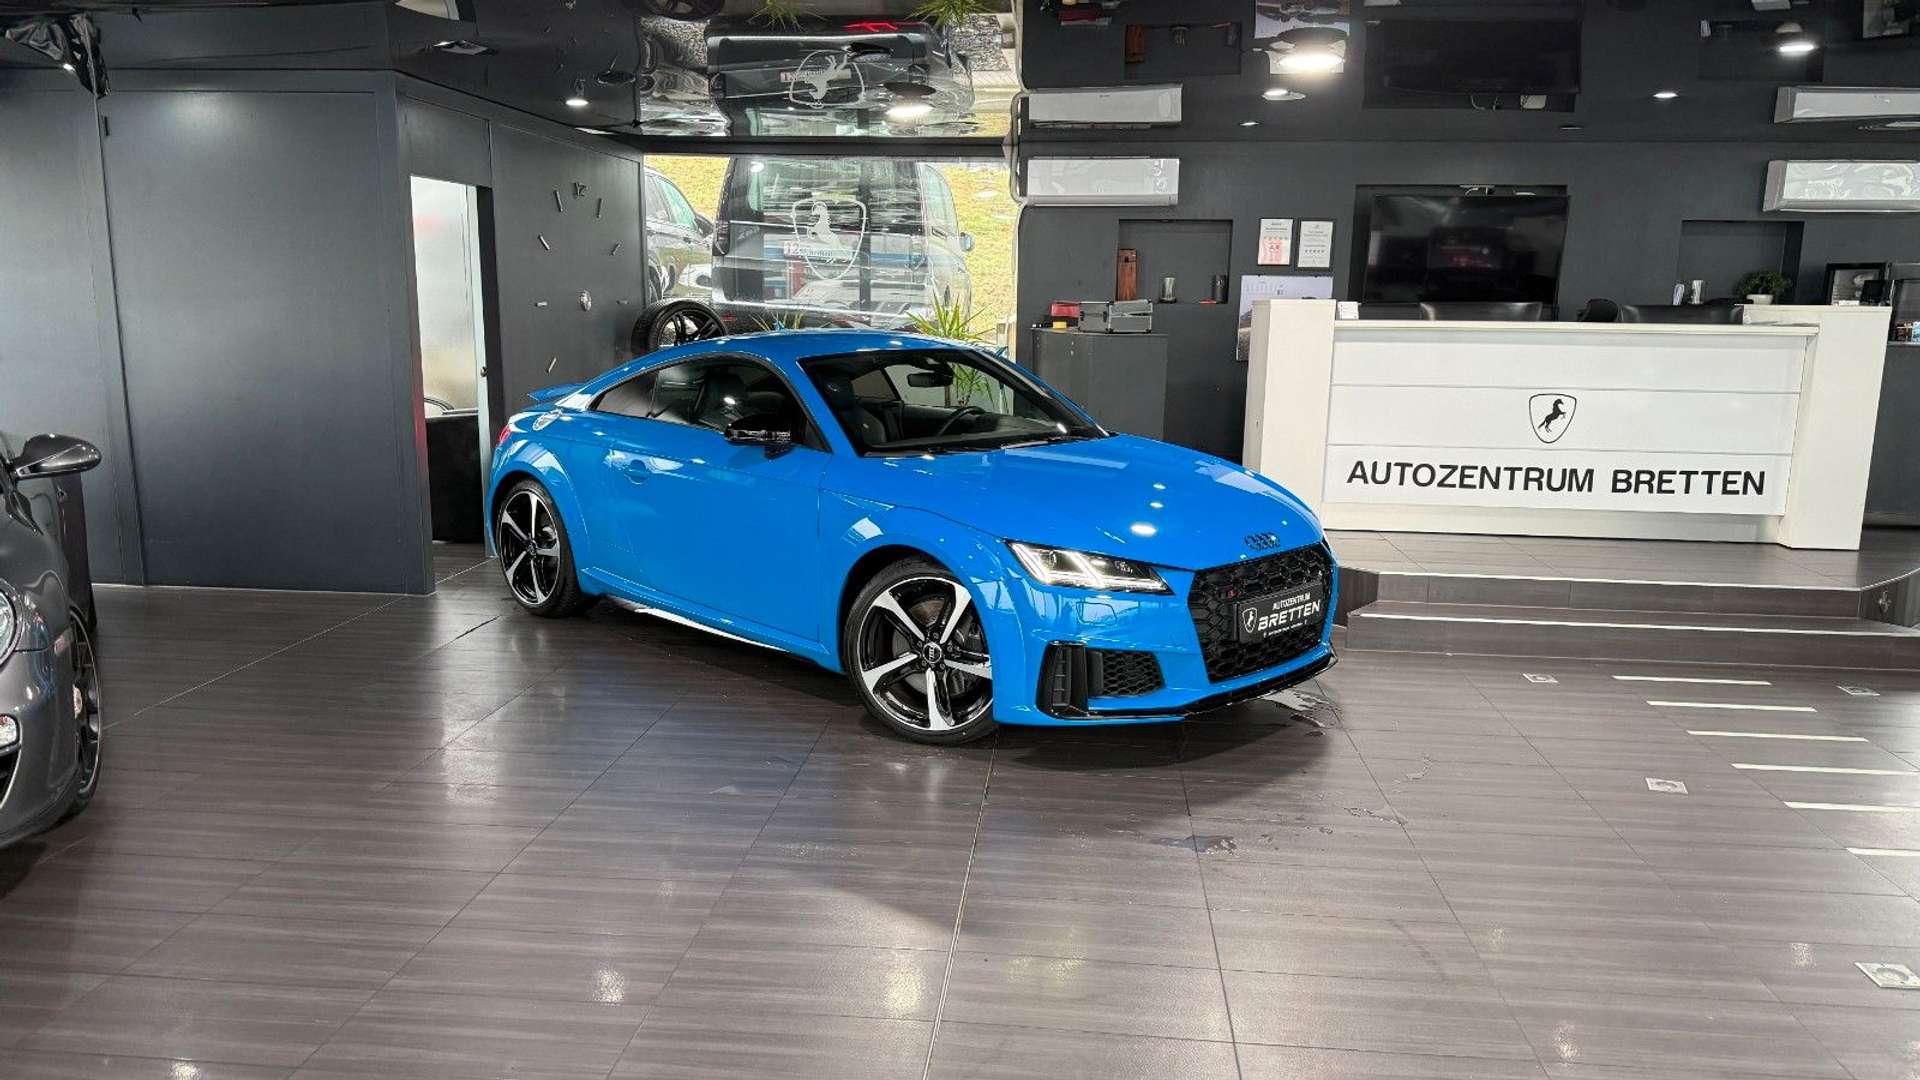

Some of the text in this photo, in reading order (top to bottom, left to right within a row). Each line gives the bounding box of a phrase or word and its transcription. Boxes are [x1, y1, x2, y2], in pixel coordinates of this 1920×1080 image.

[1347, 460, 1766, 495] AUTOZENTRUM BRETTEN
[1258, 599, 1321, 631] BRETTEN
[1272, 592, 1311, 610] AUTOZENTRUM
